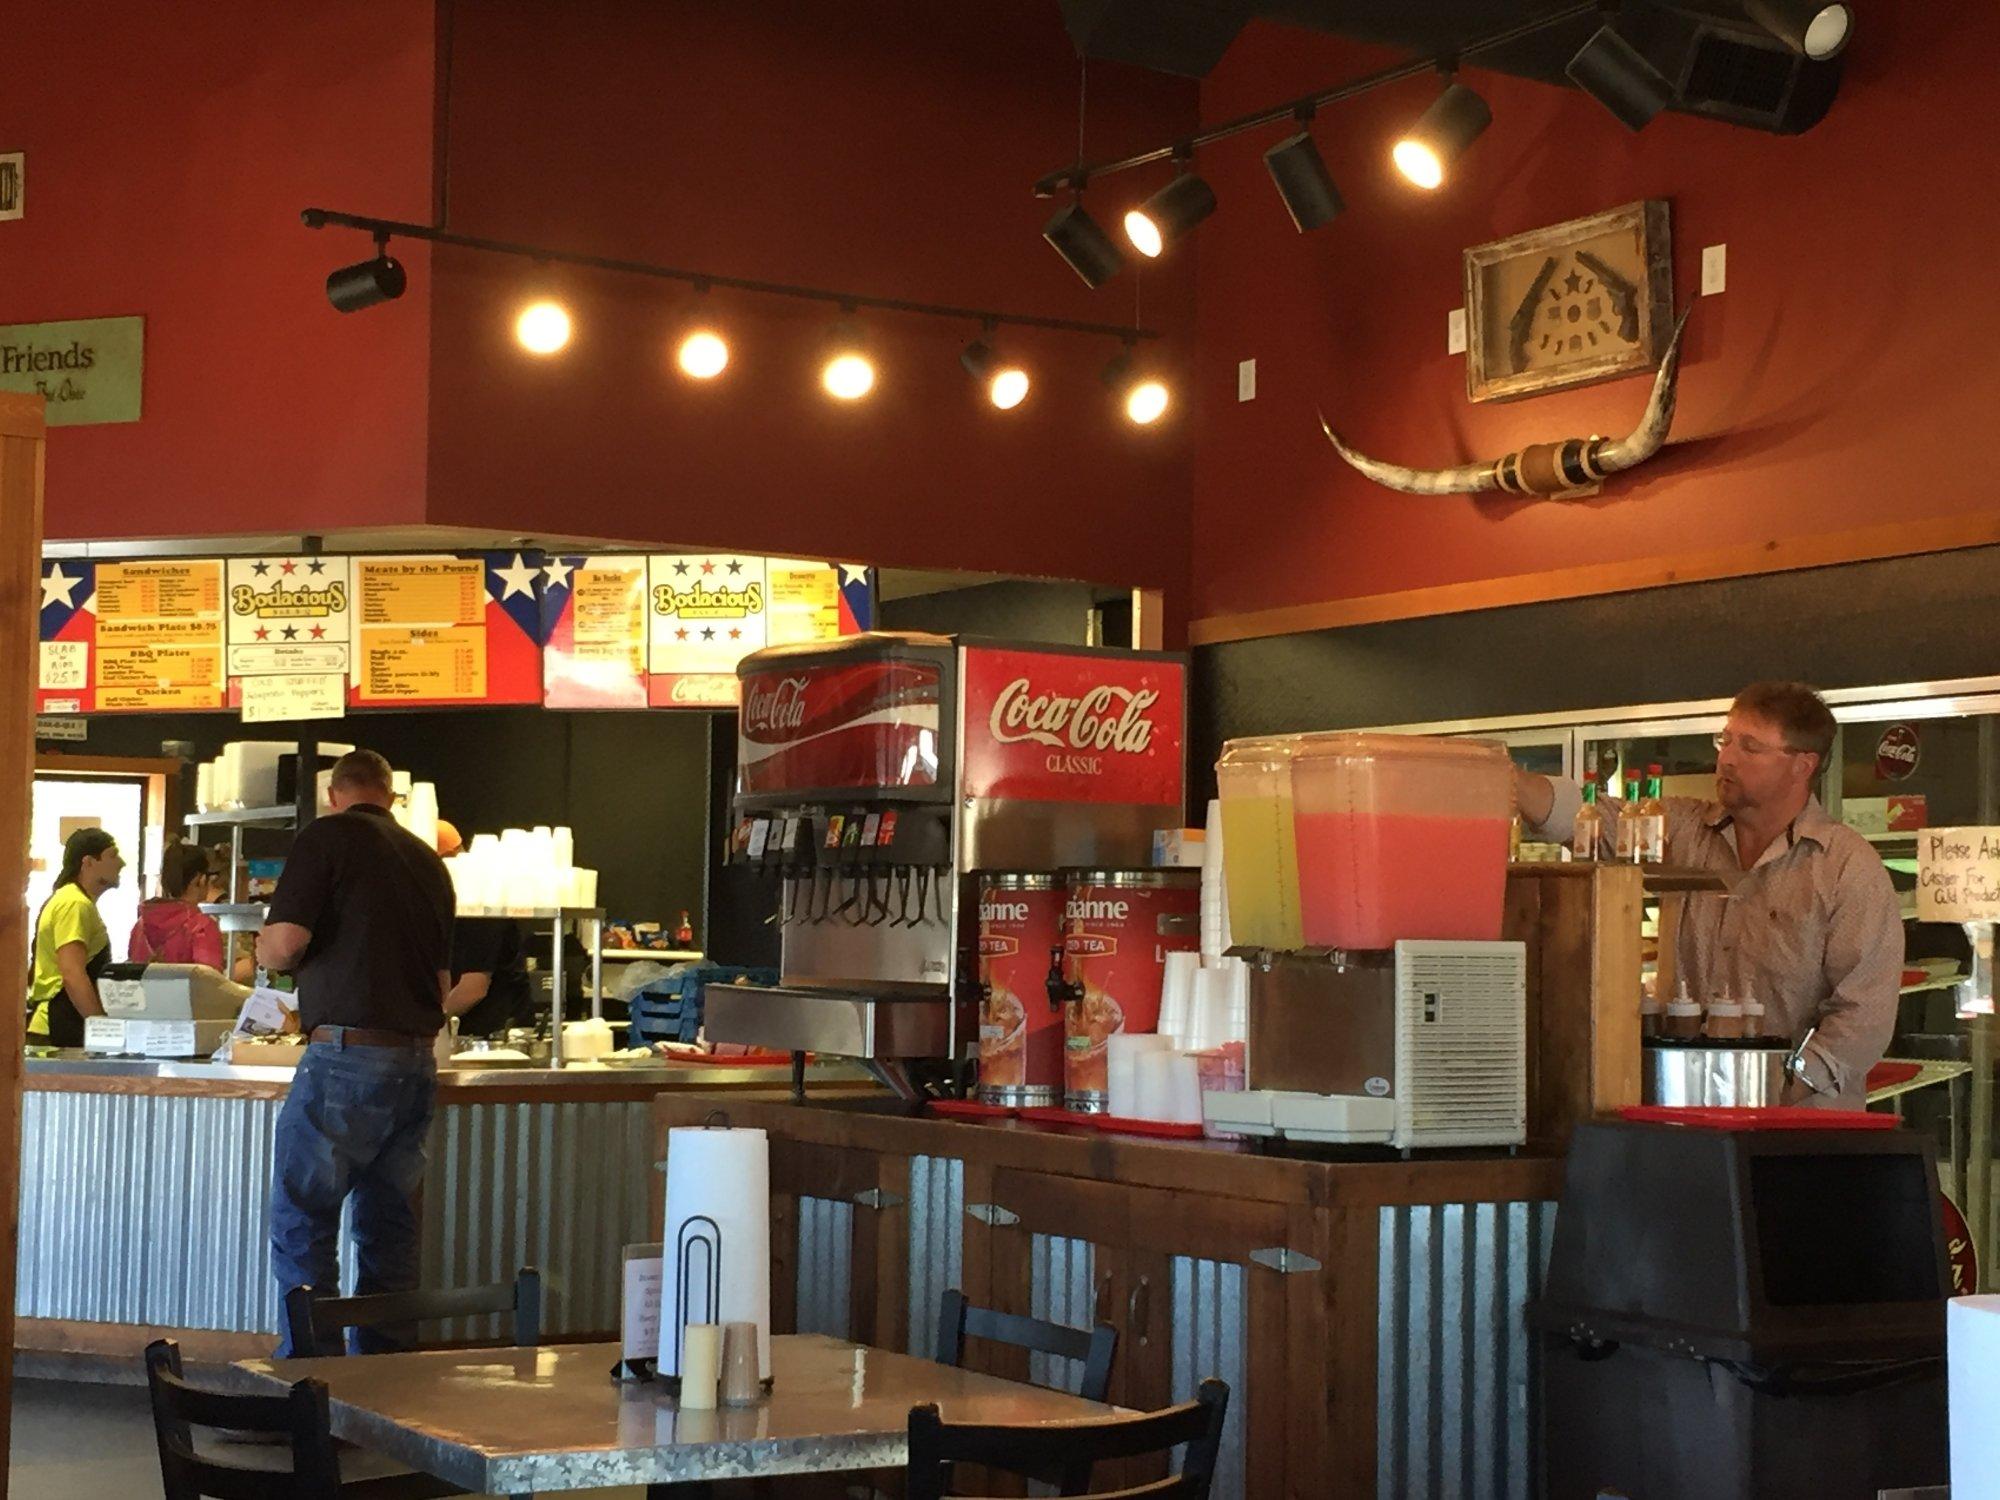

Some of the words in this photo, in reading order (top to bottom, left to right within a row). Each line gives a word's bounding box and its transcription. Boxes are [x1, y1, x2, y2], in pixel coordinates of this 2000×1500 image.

[2, 341, 95, 373] Friends
[402, 565, 416, 575] by
[420, 565, 438, 573] the
[443, 564, 479, 573] Pound
[100, 623, 154, 632] Sandwich
[158, 623, 187, 631] Plate
[410, 629, 438, 638] Sides
[130, 650, 154, 659] BBQ
[157, 649, 190, 657] Plates
[136, 688, 181, 696] Chicken
[745, 676, 811, 733] Coca-Cola
[989, 678, 1159, 753] Coca-Cola
[1046, 754, 1101, 775] CLASSIC
[1930, 835, 1970, 861] Please
[990, 940, 1008, 952] TEA
[1083, 940, 1105, 952] TEA
